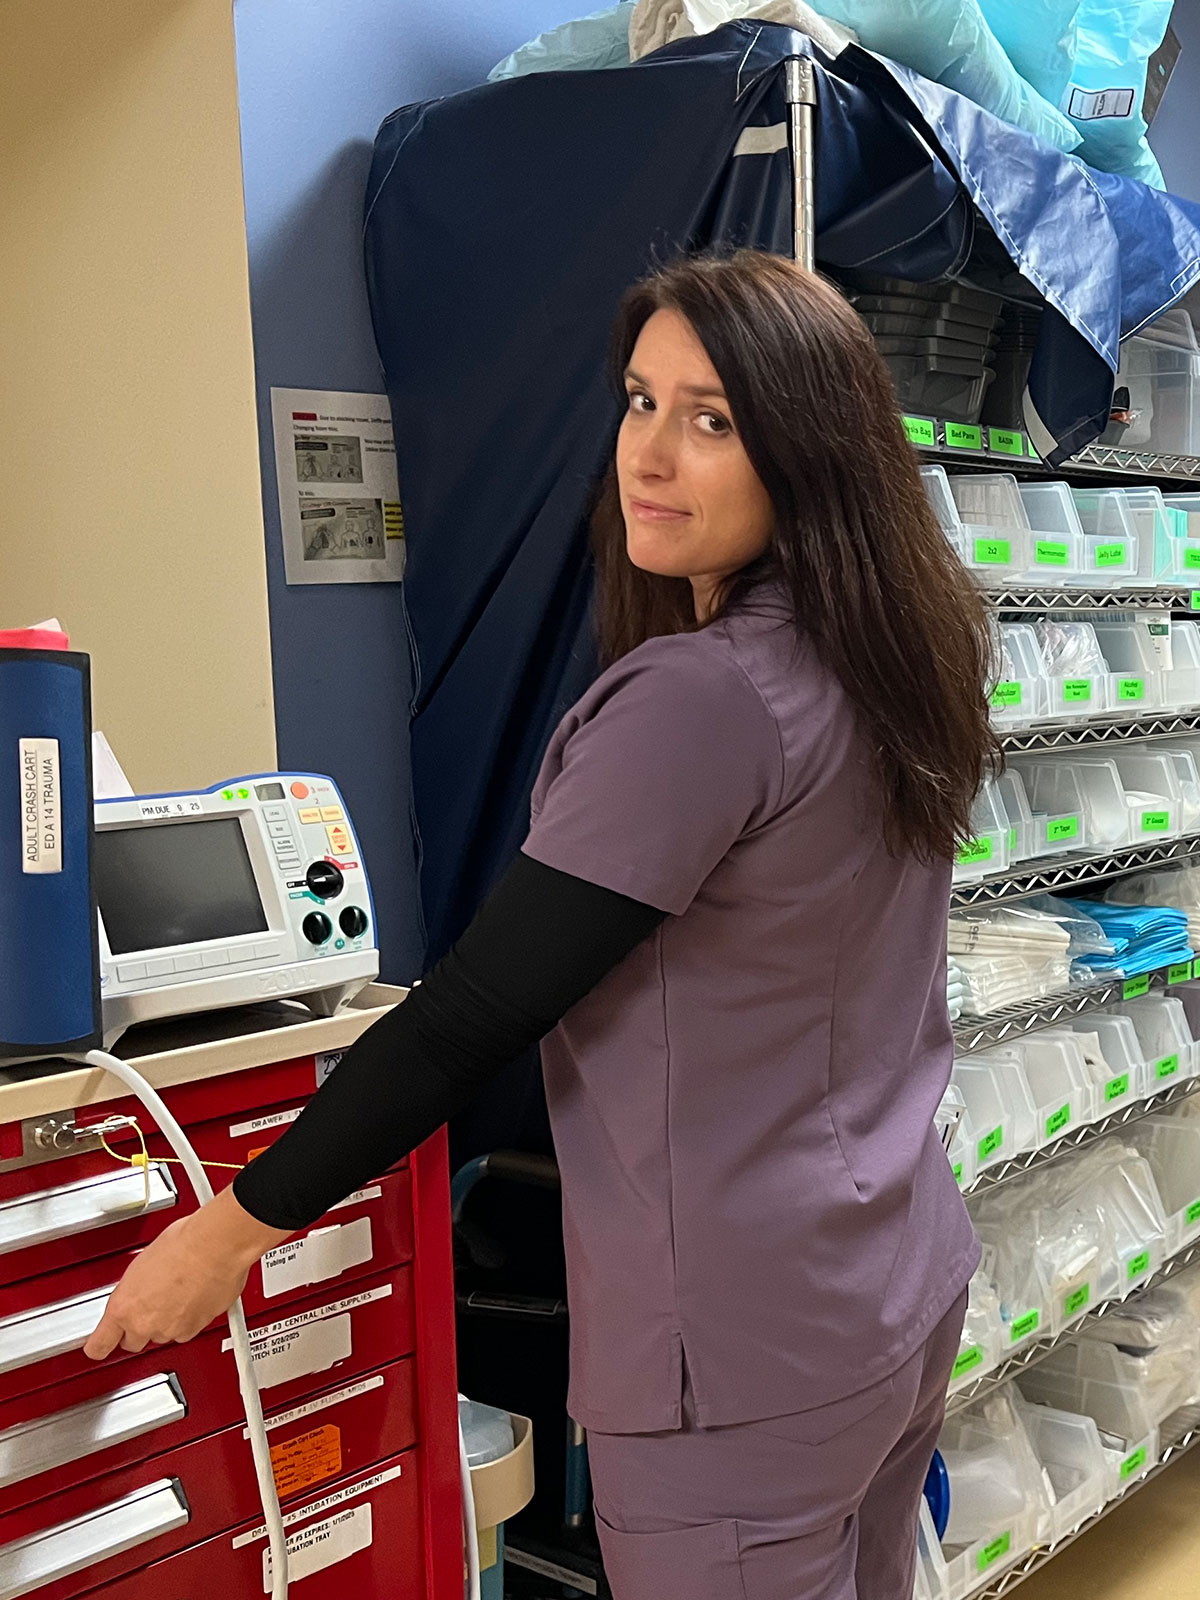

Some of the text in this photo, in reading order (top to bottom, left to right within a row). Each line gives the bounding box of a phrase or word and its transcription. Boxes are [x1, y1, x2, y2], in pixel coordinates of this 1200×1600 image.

[920, 427, 931, 438] Bag
[951, 429, 975, 441] Bed Pans
[998, 435, 1013, 445] BASIN
[988, 547, 997, 555] 2x2
[1037, 548, 1066, 558] Thermometer
[24, 750, 38, 861] ADULT CRASH CART
[43, 758, 55, 849] ED A 14 TRAUMA
[142, 807, 154, 815] PM
[155, 805, 171, 814] DUE
[251, 1115, 283, 1129] DRAWER
[265, 1241, 304, 1260] EXP 12/31/24
[265, 1253, 297, 1269] Tubing set
[249, 1292, 372, 1339] AWER #3 CENTRAL LINE SUPPLIES
[272, 1346, 285, 1355] SIZE
[299, 1493, 342, 1518] INTUBATION
[344, 1474, 383, 1496] EQUIPMENT
[304, 1522, 331, 1540] EXPIRES:
[315, 1531, 331, 1543] TRAY
